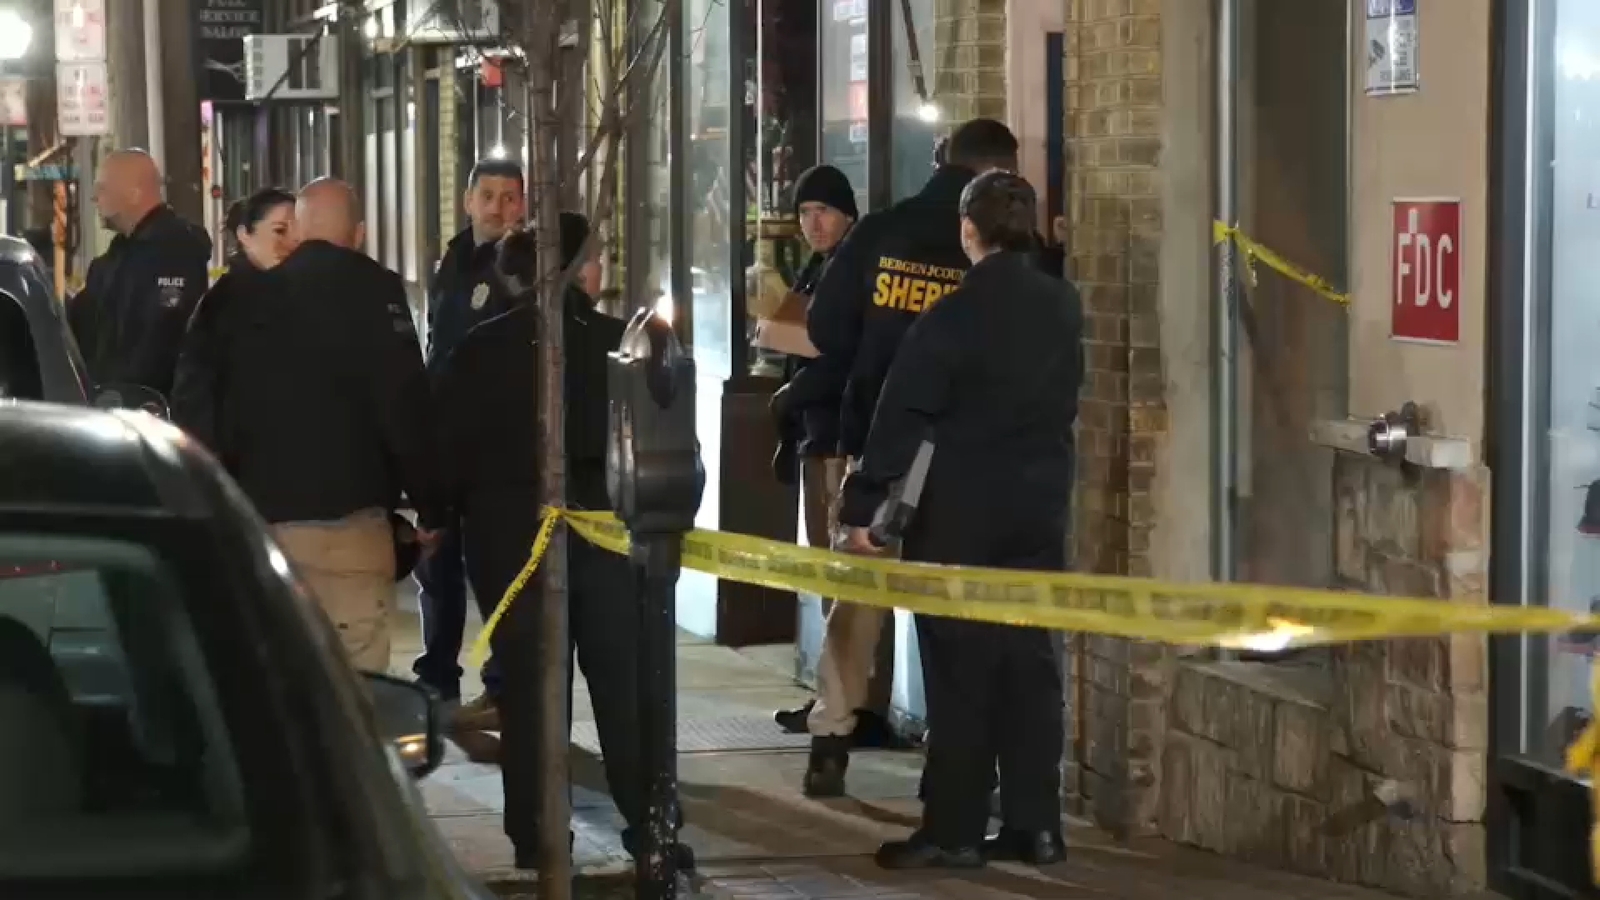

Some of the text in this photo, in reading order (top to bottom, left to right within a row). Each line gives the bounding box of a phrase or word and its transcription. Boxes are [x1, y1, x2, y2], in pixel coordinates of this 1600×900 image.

[879, 256, 926, 275] BERGEN
[1398, 233, 1453, 309] FDC
[158, 277, 185, 287] POLICE
